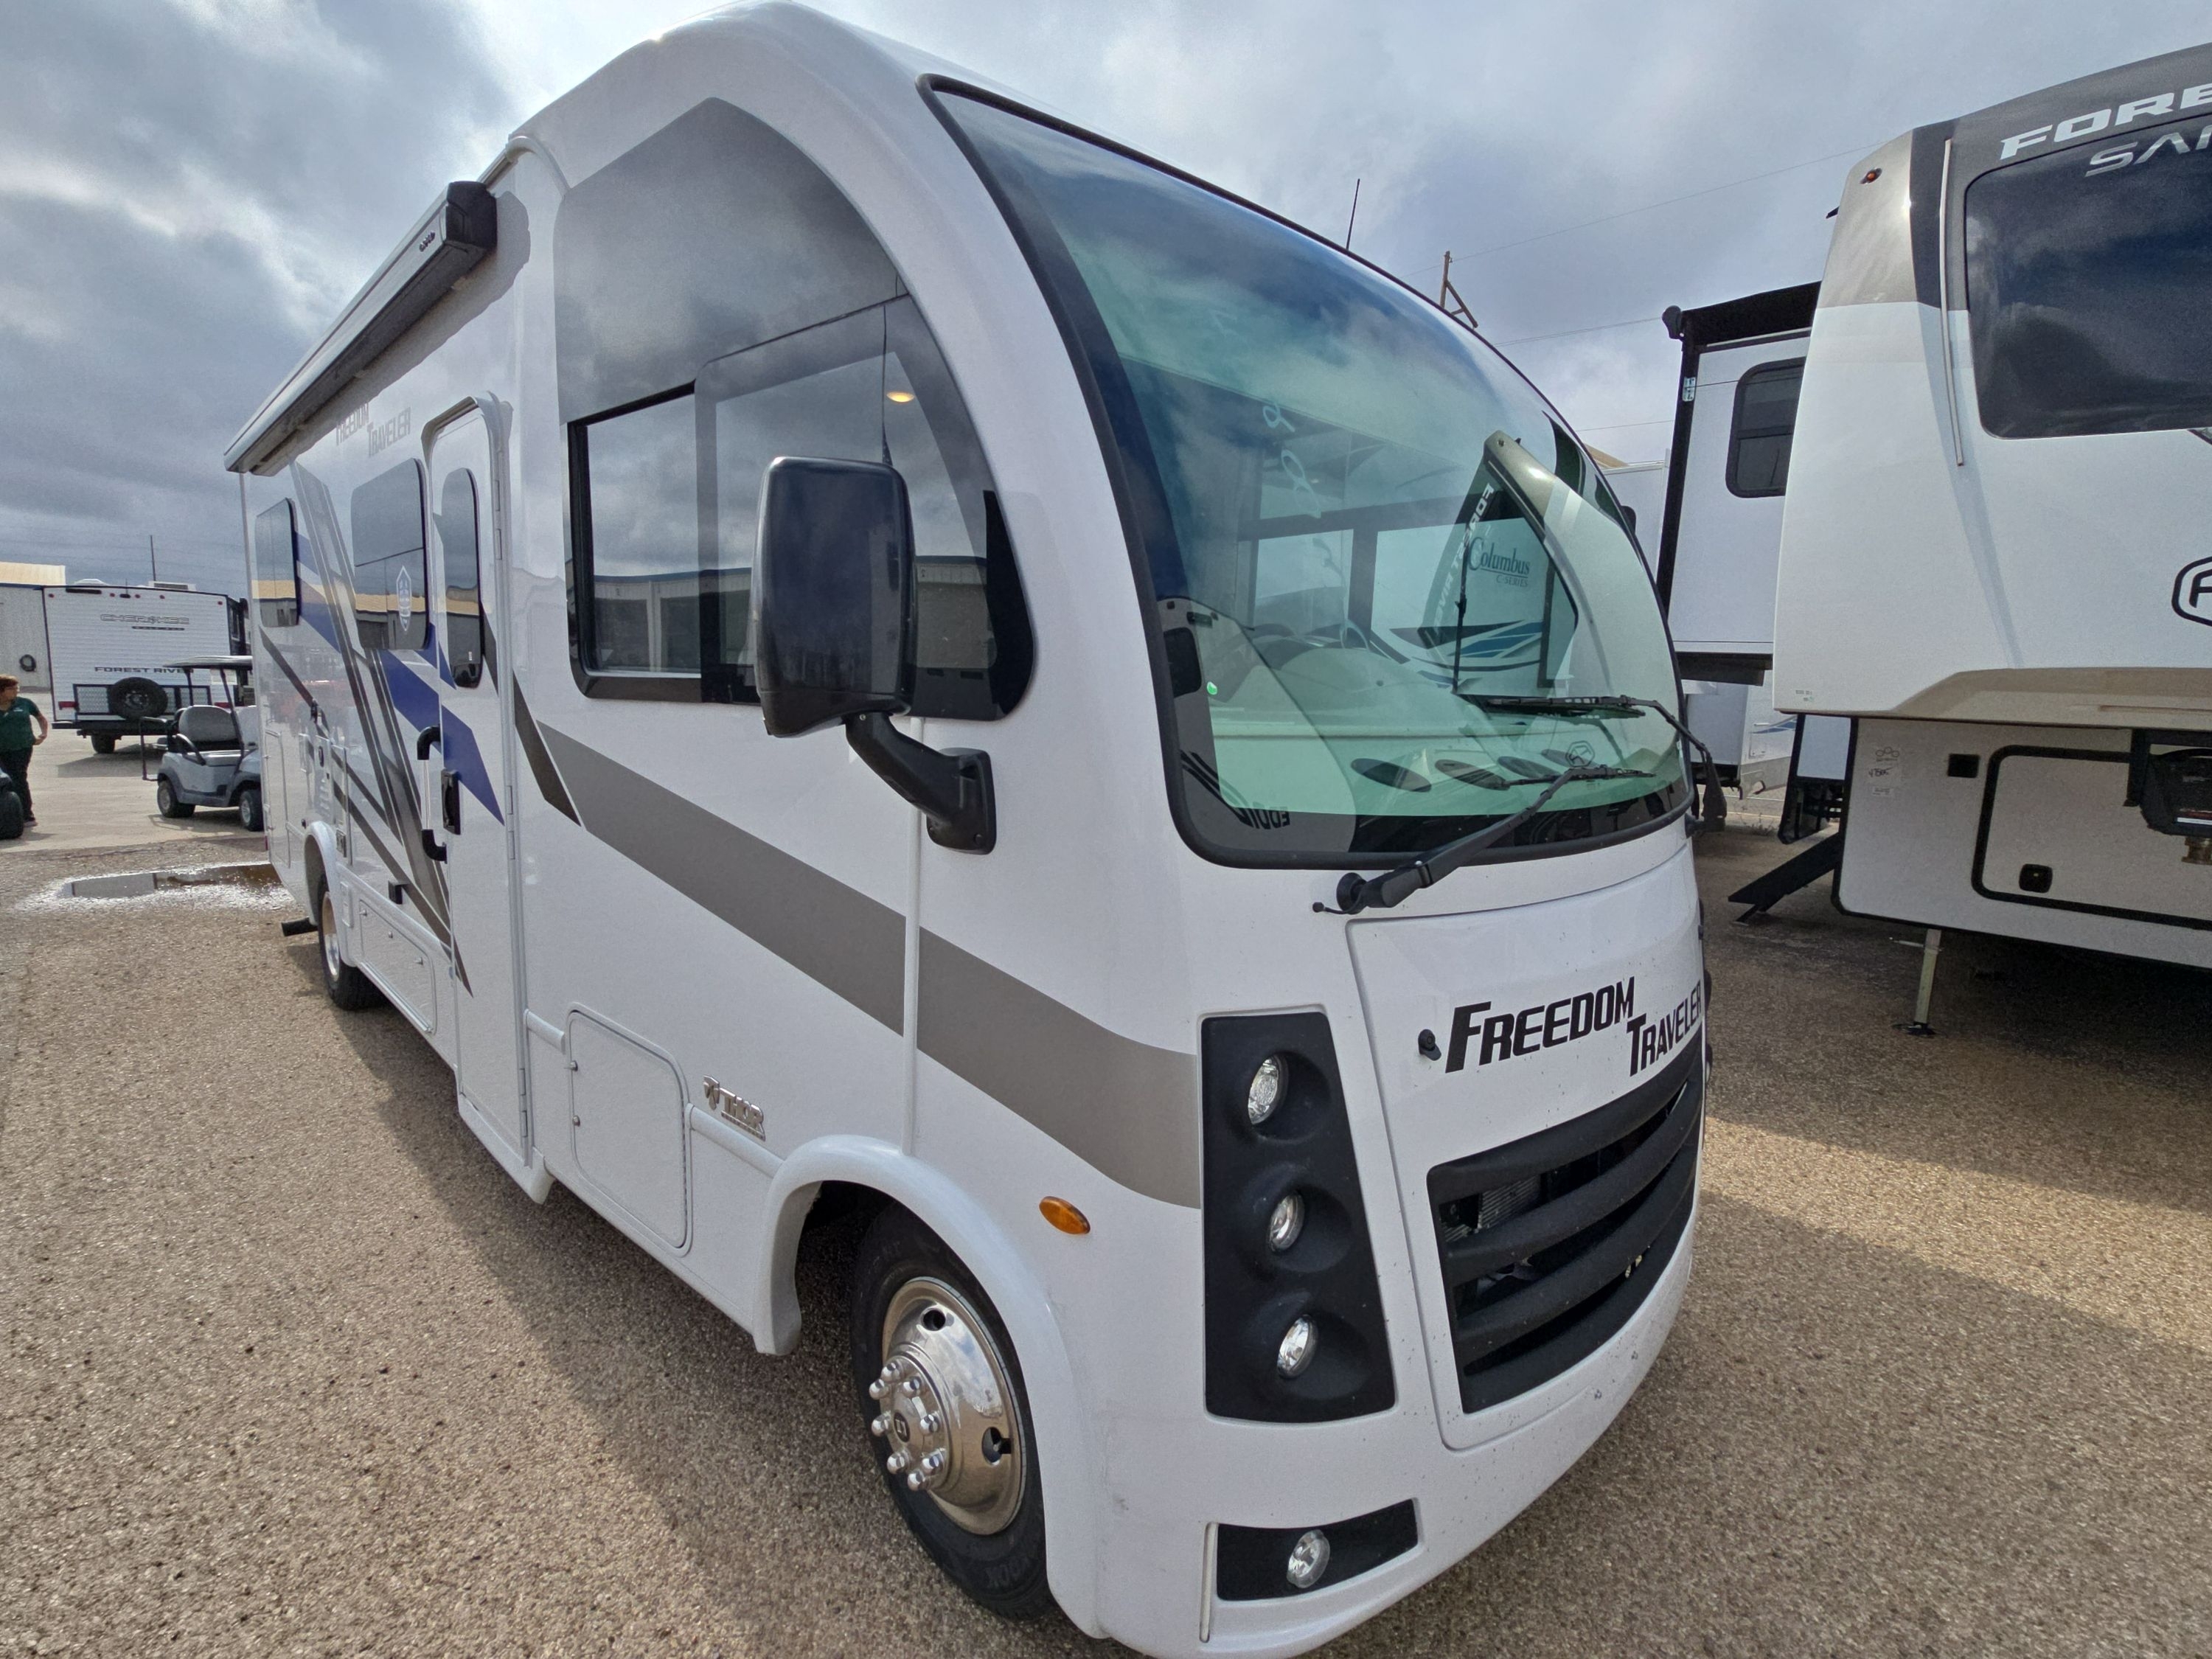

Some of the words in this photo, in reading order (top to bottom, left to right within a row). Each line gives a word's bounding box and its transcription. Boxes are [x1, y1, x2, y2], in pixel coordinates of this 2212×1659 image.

[366, 406, 411, 457] TRAVELER
[1468, 536, 1531, 575] Columbus
[1444, 975, 1635, 1074] FREEDOM
[1627, 980, 1703, 1077] TRAVELER
